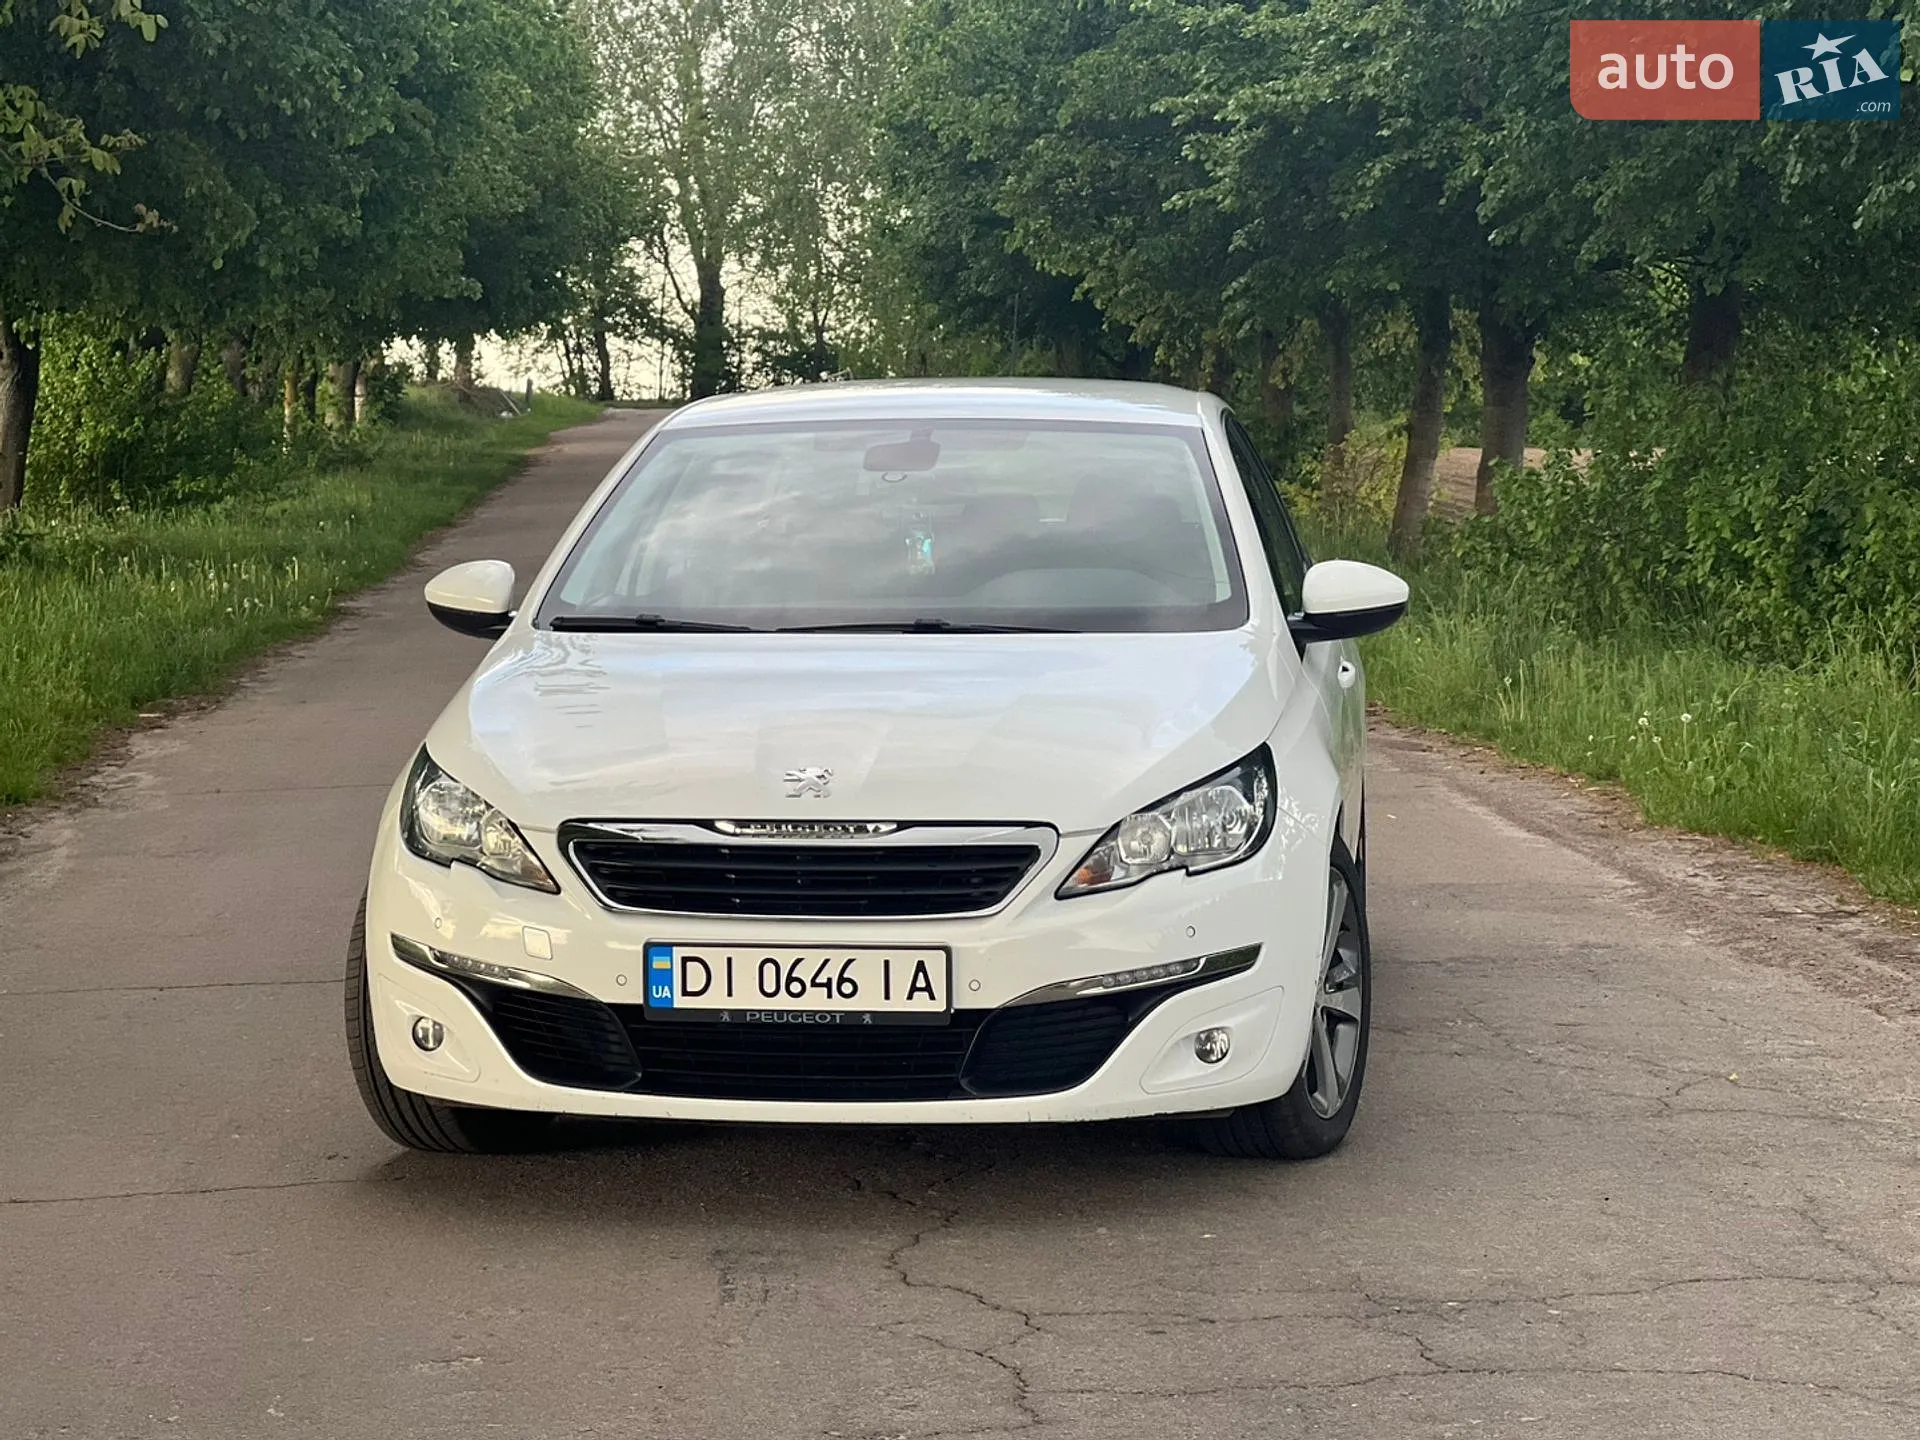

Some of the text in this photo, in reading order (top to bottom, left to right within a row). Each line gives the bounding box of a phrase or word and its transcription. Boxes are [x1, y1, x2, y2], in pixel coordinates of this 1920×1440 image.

[680, 956, 936, 1001] DI 0646 IA
[652, 985, 672, 999] UA
[746, 1011, 845, 1024] PEUGEOT
